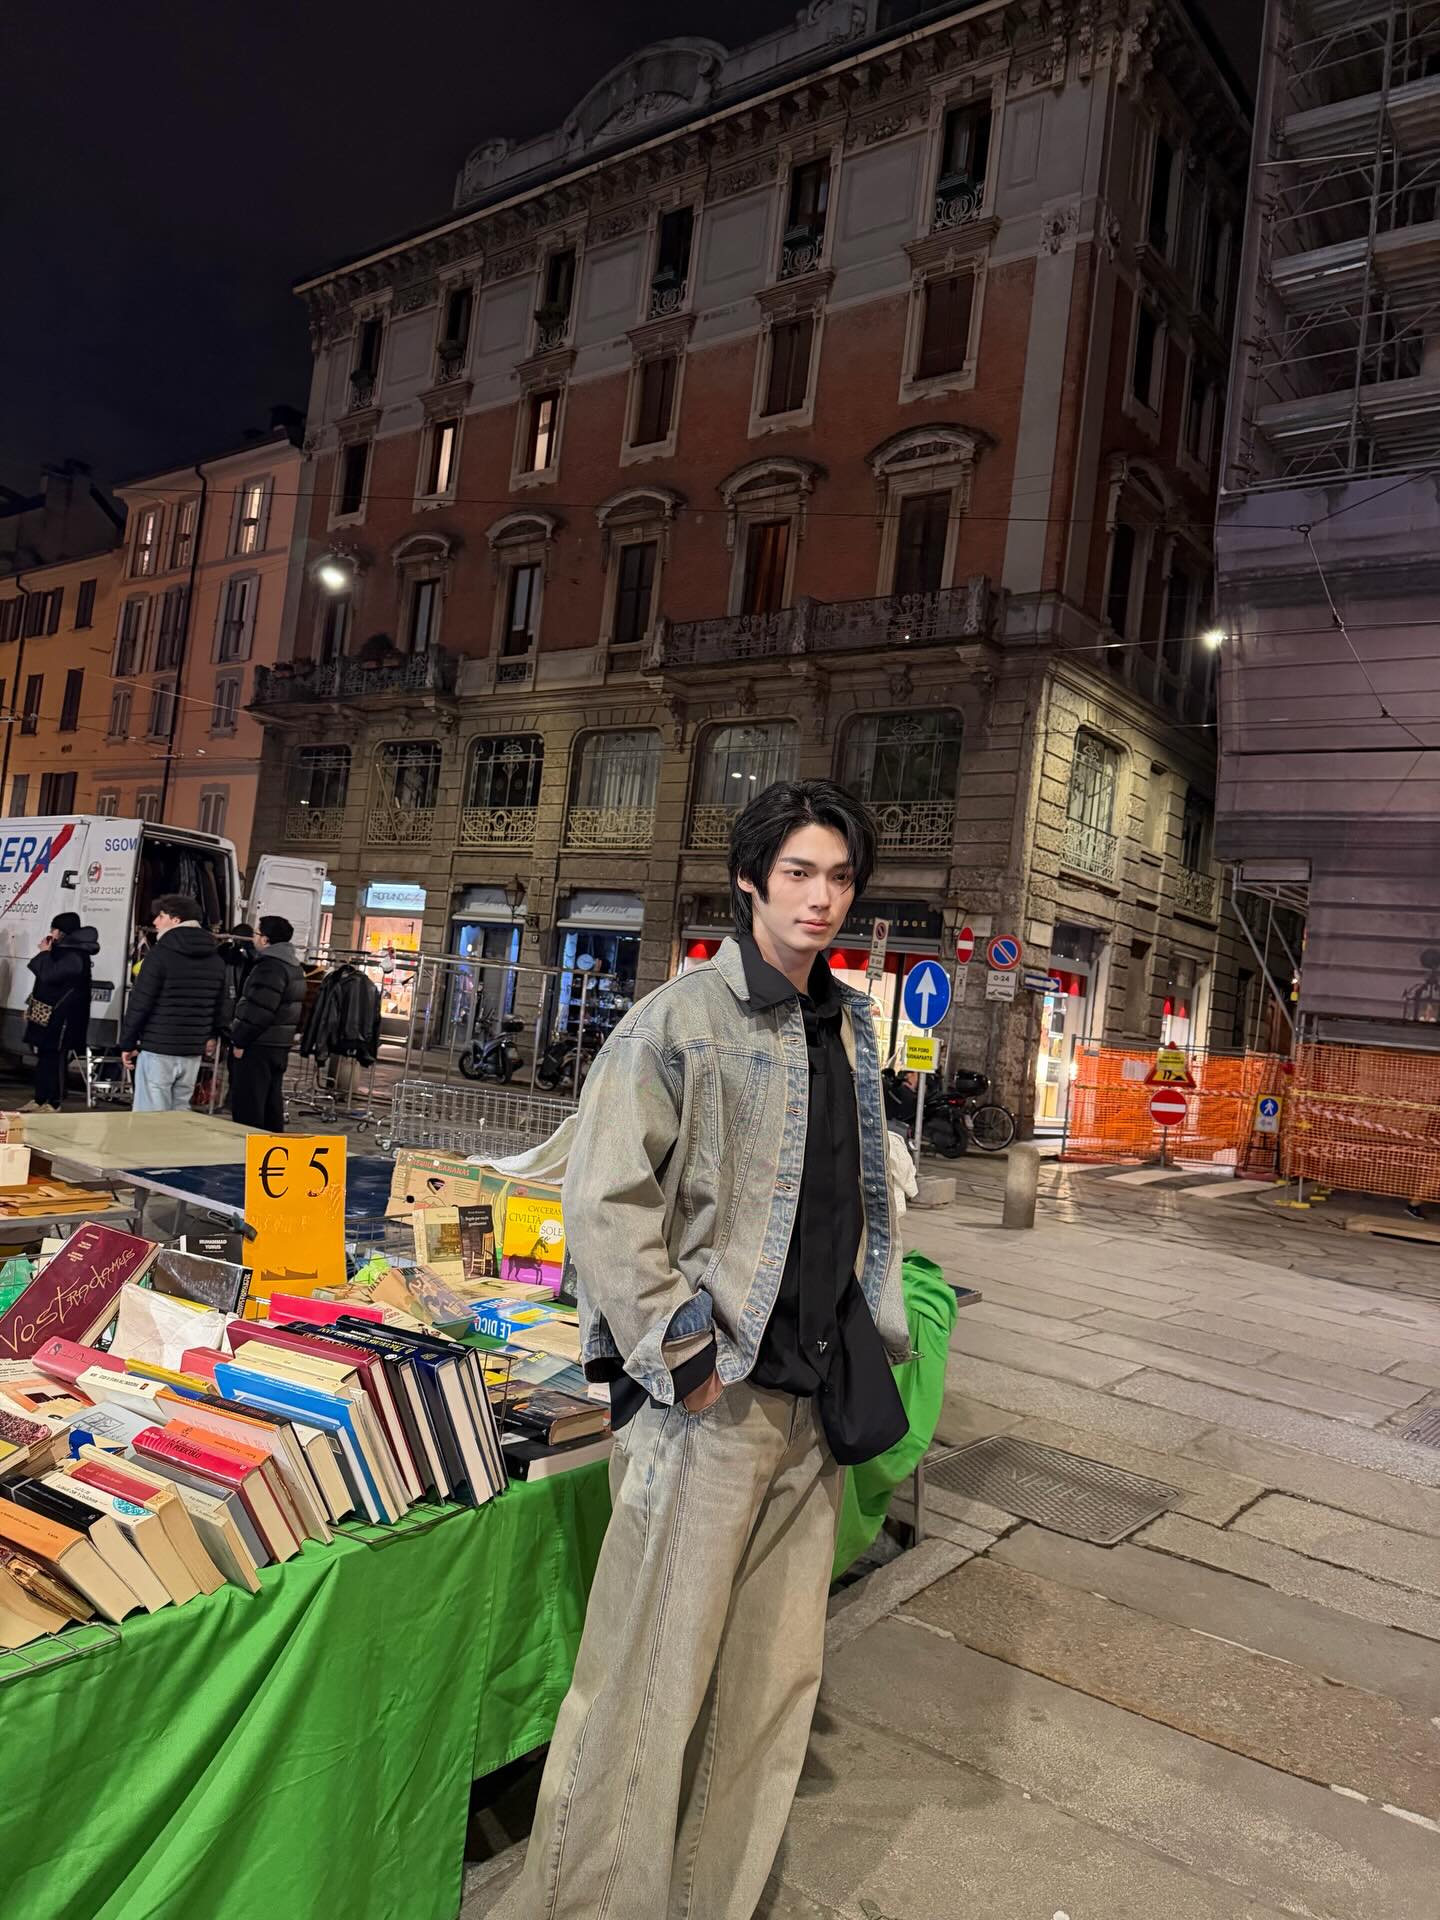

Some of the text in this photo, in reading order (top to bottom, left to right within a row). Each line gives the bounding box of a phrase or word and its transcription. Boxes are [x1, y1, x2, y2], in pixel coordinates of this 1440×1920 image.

[0, 837, 53, 873] ERA
[258, 1146, 329, 1198] € 5
[540, 1225, 563, 1236] SOLE
